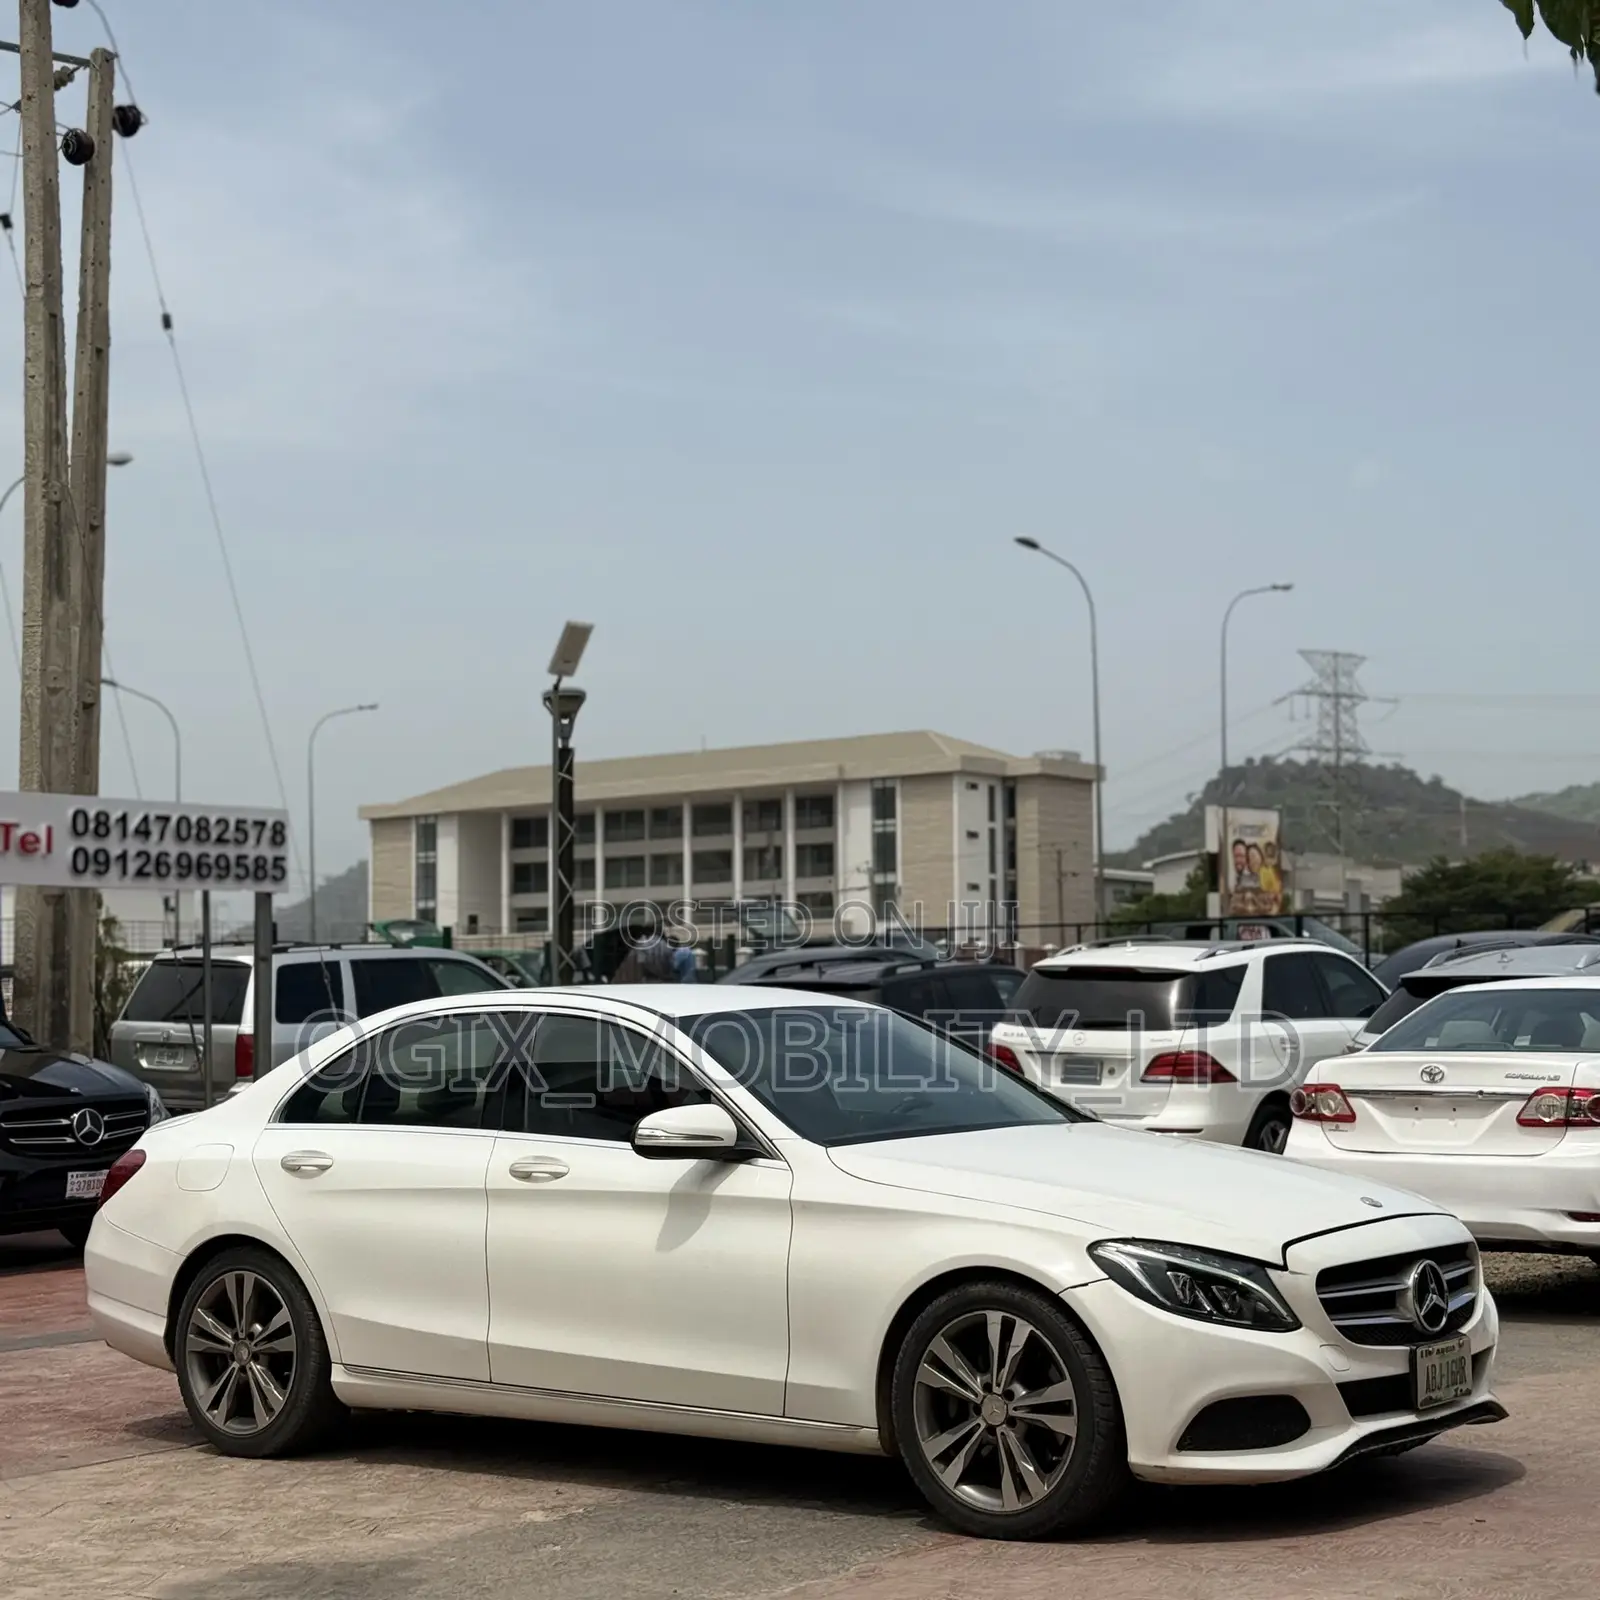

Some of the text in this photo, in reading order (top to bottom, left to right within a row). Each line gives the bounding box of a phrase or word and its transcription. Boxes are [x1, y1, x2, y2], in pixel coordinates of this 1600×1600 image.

[0, 823, 53, 854] Tel
[71, 809, 286, 847] 08147082578
[71, 847, 286, 882] 09126969585
